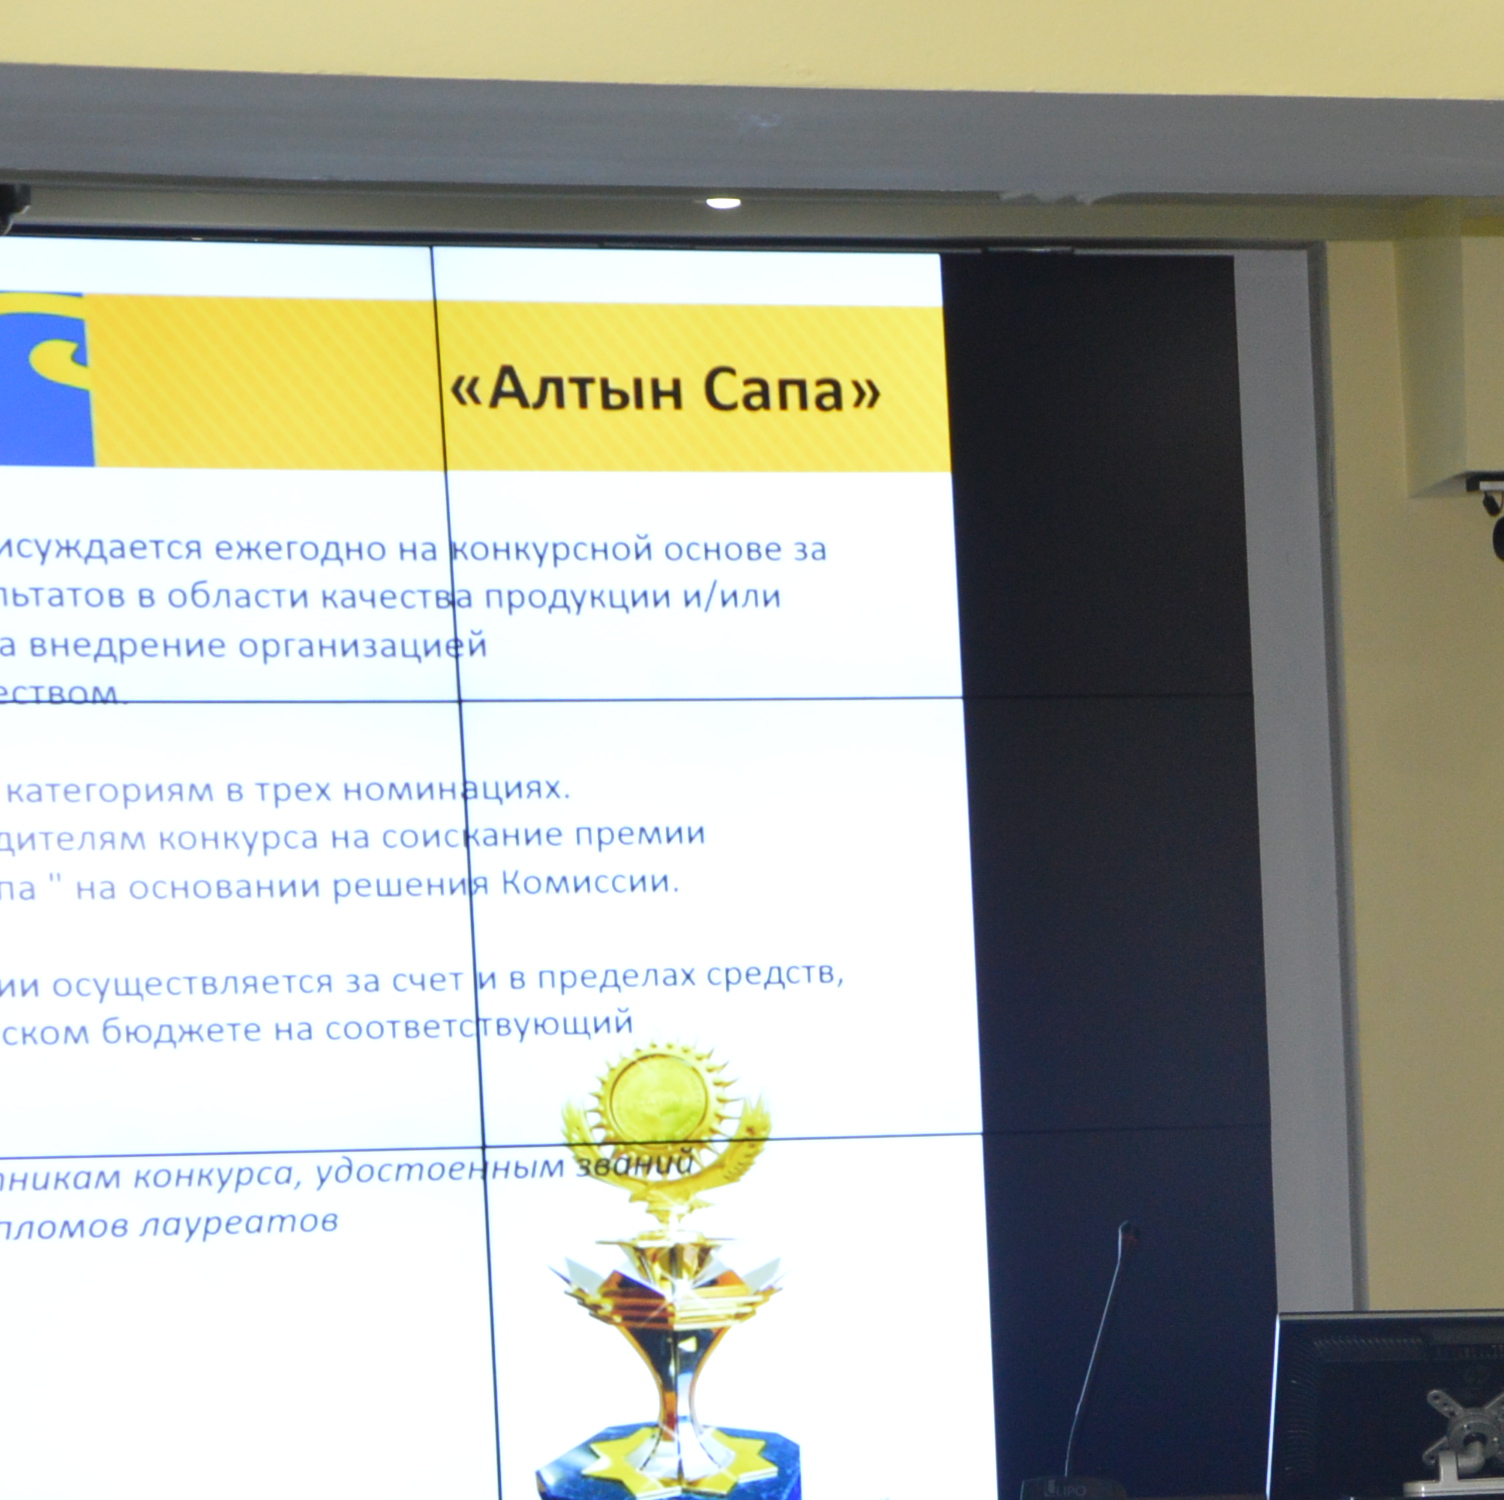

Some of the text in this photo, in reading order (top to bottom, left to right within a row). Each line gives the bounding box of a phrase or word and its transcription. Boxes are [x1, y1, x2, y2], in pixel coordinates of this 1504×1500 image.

[450, 363, 882, 412] «Алтын Сапа»
[0, 533, 827, 569] исуждается ежегодно на конкурсной основе за
[137, 587, 156, 609] в
[167, 579, 309, 609] области
[321, 587, 473, 610] качества
[485, 588, 671, 616] продукции
[683, 579, 780, 613] и/или
[29, 636, 226, 665] внедрение
[238, 630, 488, 665] организацией
[6, 779, 570, 810] категориям в трех номинациях.
[0, 824, 705, 857] дителям конкурса на соискание премии
[76, 880, 116, 901] на
[129, 878, 320, 900] основании
[333, 874, 489, 904] решения
[502, 869, 678, 895] Комиссии.
[0, 964, 843, 1004] ии осуществляется за счет и в пределах средств,
[1, 1008, 634, 1050] ском бюджете на соответствующий
[0, 1145, 696, 1194] никам конкурса, удостоенным званий
[138, 1212, 339, 1244] лауреатов
